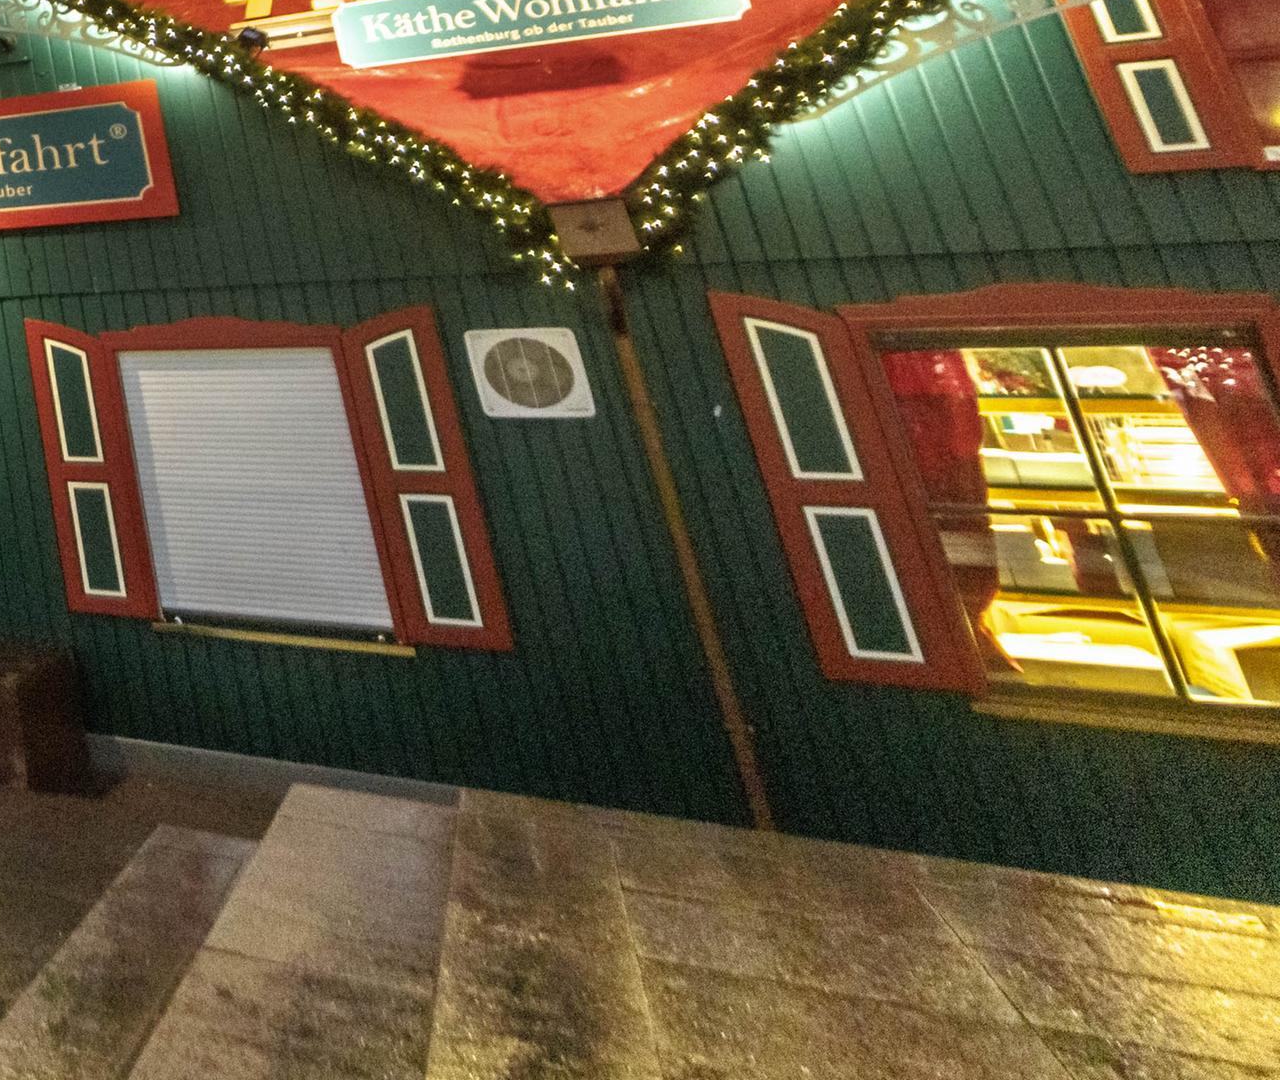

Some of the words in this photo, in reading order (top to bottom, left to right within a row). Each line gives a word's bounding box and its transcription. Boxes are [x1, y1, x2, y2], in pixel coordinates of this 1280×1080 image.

[363, 5, 476, 43] Käthe
[522, 24, 544, 37] ob
[546, 21, 573, 33] der
[576, 14, 634, 29] Tauber
